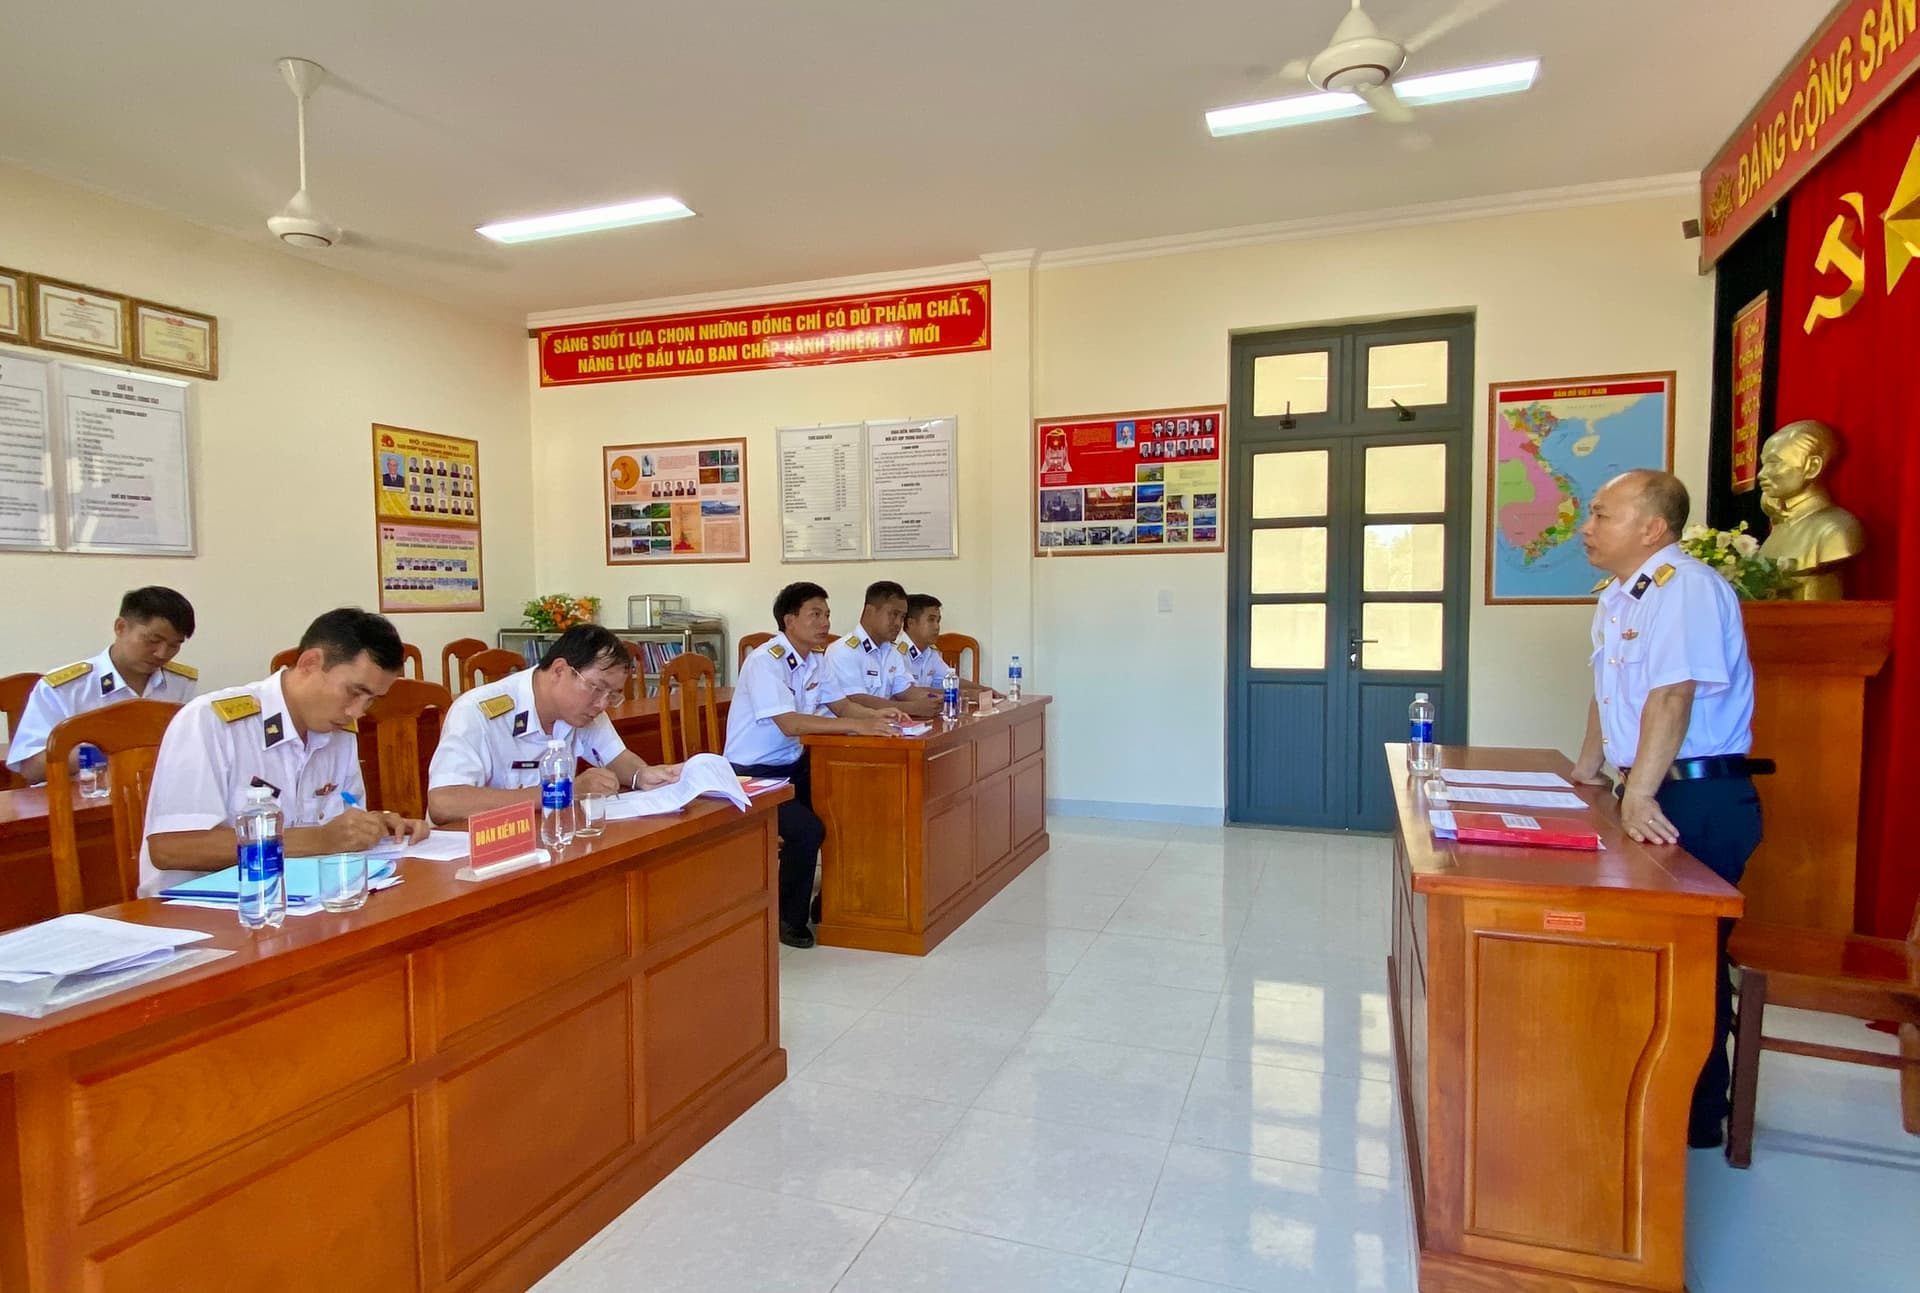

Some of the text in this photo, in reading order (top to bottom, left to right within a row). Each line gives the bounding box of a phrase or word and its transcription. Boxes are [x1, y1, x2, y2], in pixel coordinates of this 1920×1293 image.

[1739, 111, 1786, 208] ĐẢNG
[1790, 36, 1853, 151] CỘNG
[553, 292, 971, 354] SÁNG SUỐT LỰA CHỌN NHỮNG ĐỒNG CHÍ CÓ ĐỦ PHẨM CHẤT,
[578, 357, 614, 373] NĂNG
[618, 353, 642, 373] LỰC
[677, 346, 704, 365] VÀO
[708, 345, 737, 362] BAN
[742, 336, 780, 359] CHẤP
[784, 336, 825, 356] HÀNH
[829, 330, 880, 353] NHIỆM
[909, 323, 940, 345] MỚI
[475, 818, 530, 846] ĐOÀN KIỂM TRA
